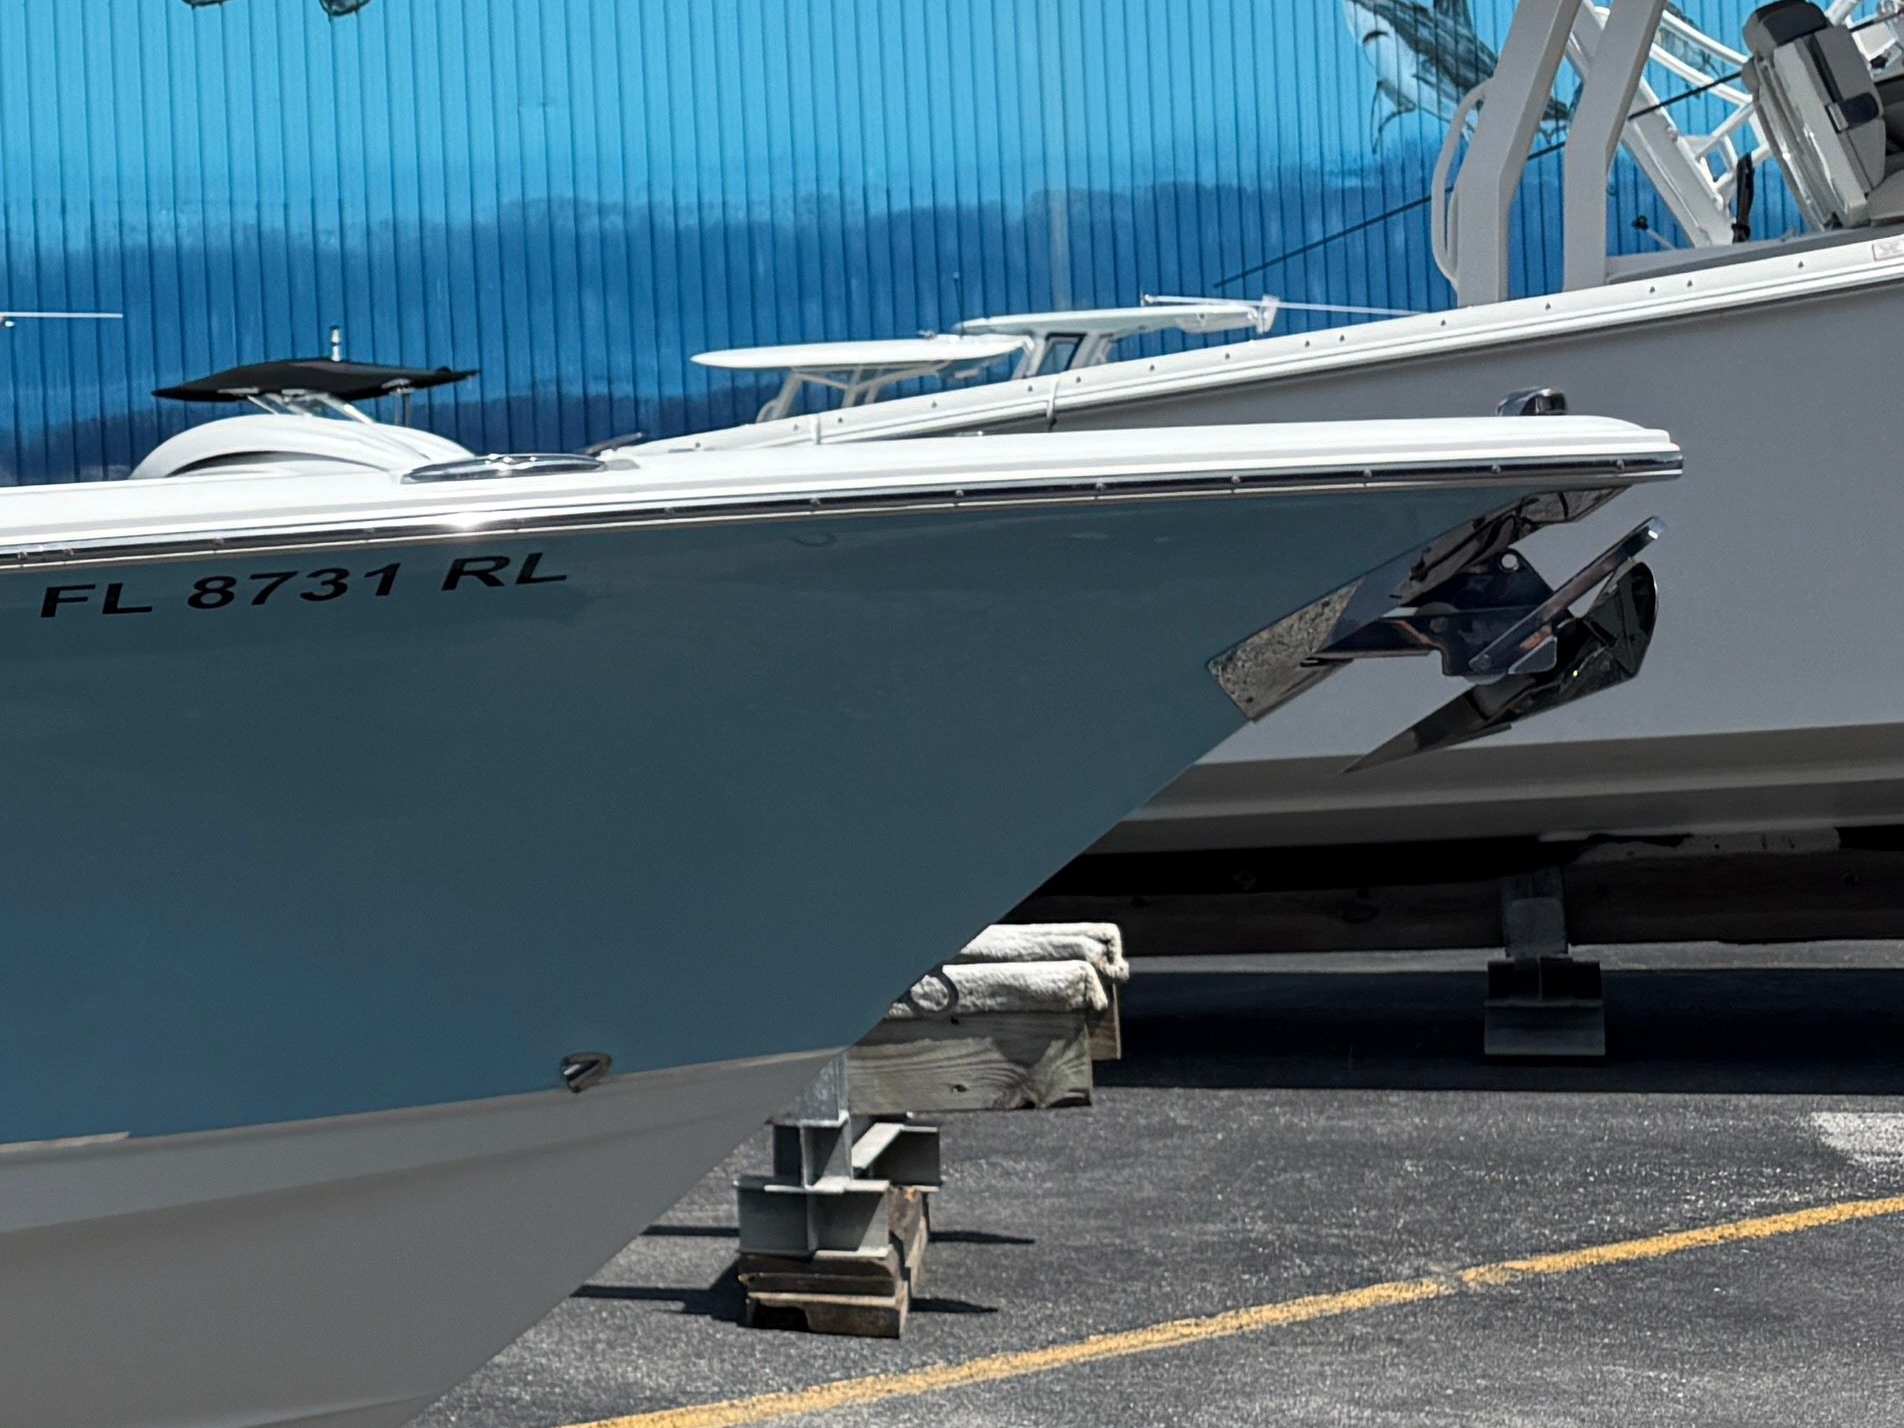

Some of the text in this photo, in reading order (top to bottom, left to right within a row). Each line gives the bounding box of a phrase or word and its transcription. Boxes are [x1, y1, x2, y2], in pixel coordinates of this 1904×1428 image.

[40, 551, 568, 618] FL 8731 RL
